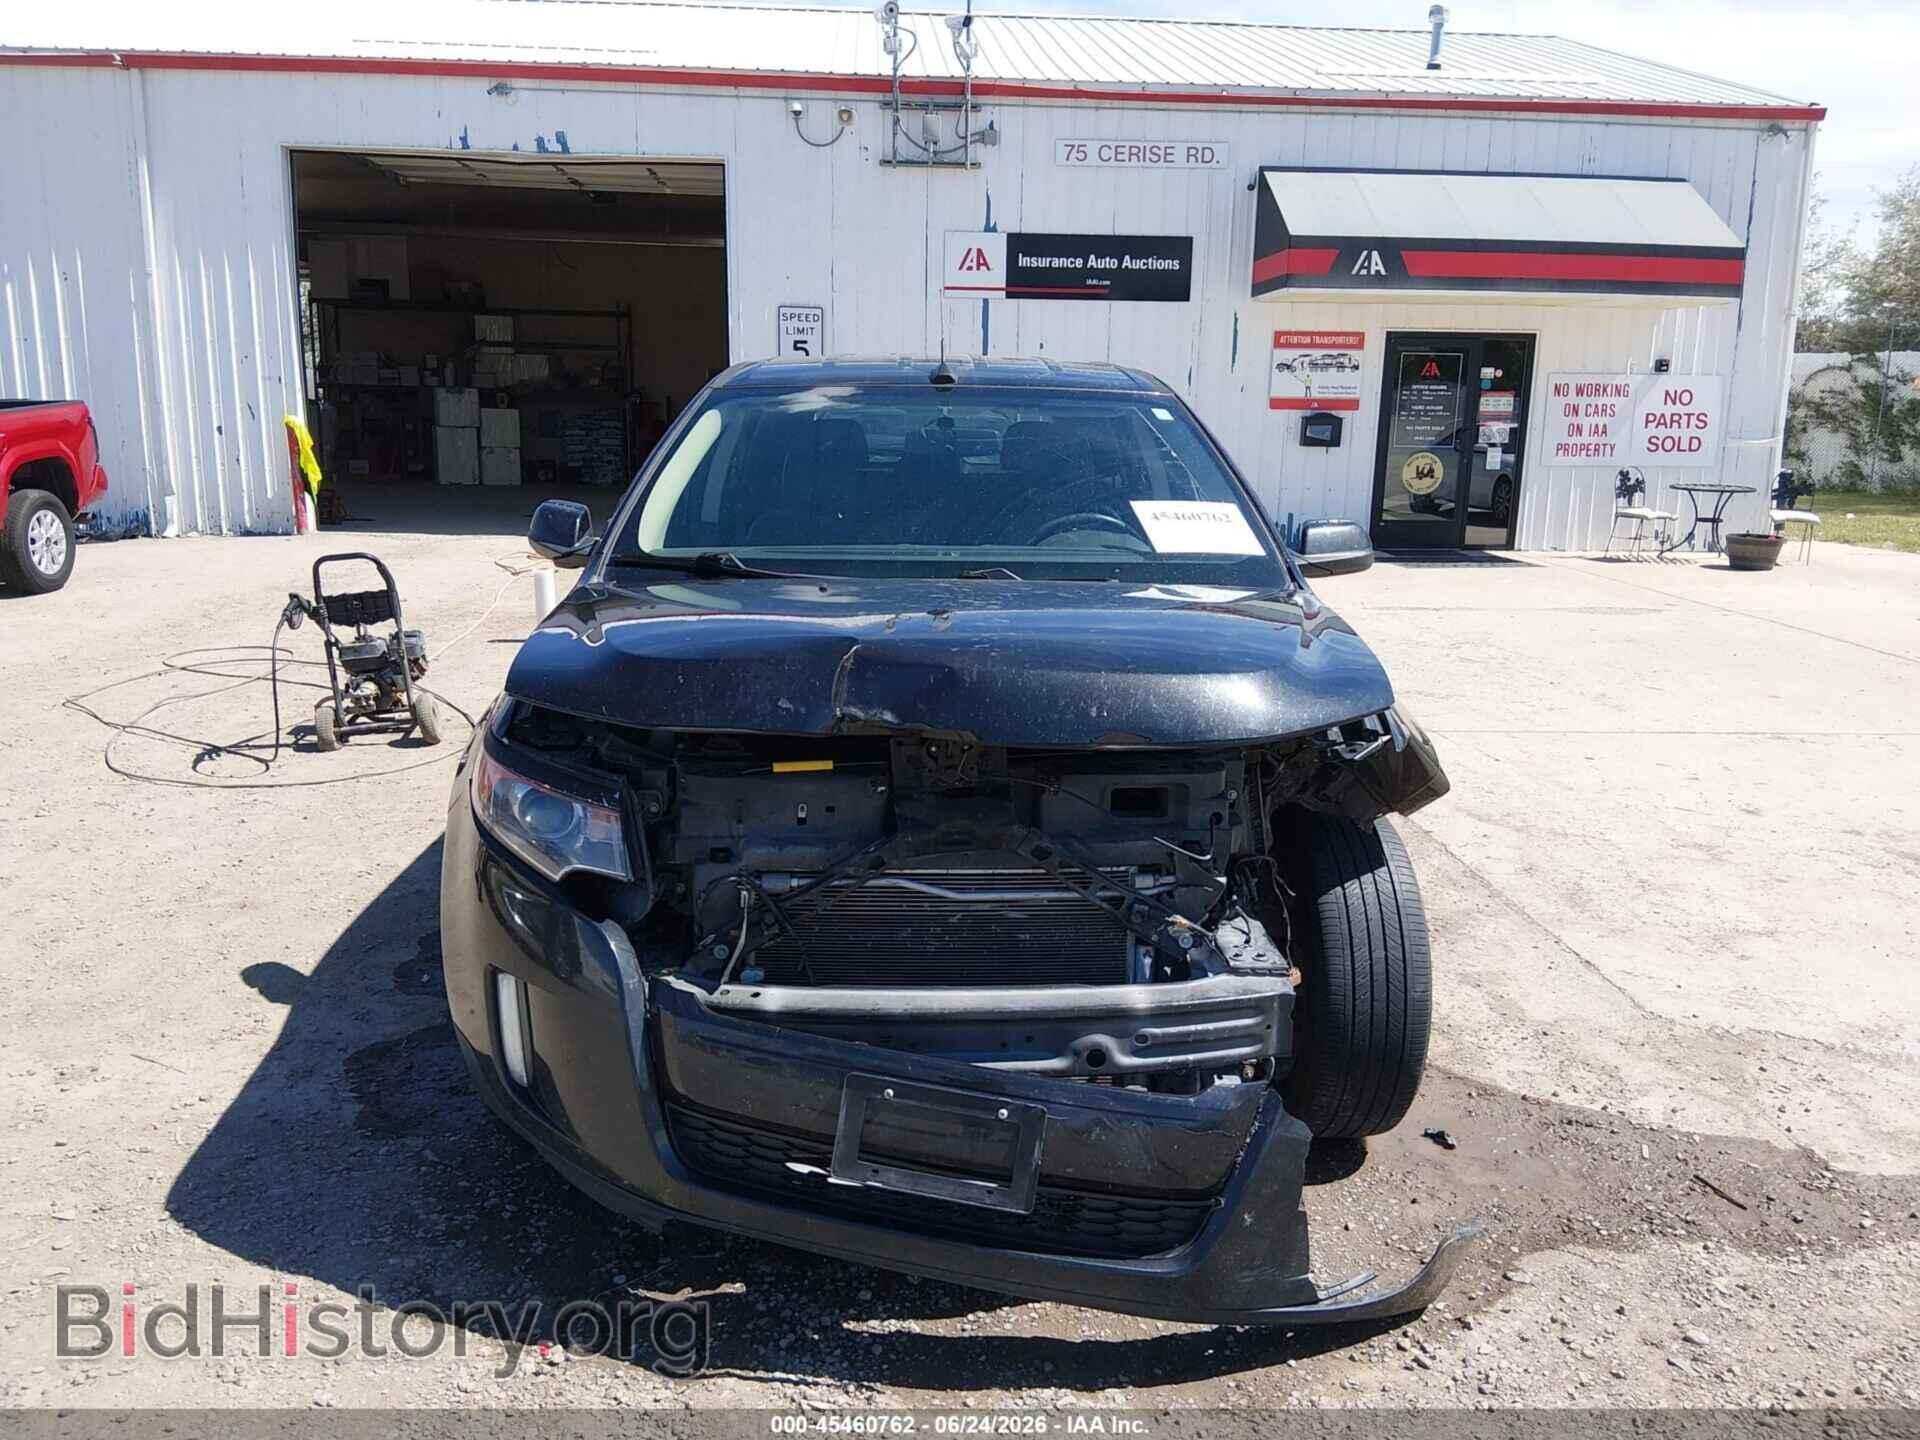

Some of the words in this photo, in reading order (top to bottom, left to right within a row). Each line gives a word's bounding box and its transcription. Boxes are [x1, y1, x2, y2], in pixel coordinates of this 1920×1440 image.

[1064, 144, 1088, 162] 75
[1098, 144, 1176, 164] CERISE
[1186, 146, 1220, 164] RD.
[1018, 253, 1083, 268] Insurance
[1087, 254, 1118, 269] Auto
[1121, 255, 1180, 270] Auctions
[782, 312, 820, 322] SPEED
[786, 326, 815, 336] LIMIT
[1280, 335, 1311, 345] ATTENTION
[1553, 383, 1570, 398] NO
[1575, 383, 1630, 398] WORKING
[1664, 389, 1693, 406] NO
[1563, 403, 1579, 417] ON
[1585, 403, 1616, 418] CARS
[1644, 412, 1708, 430] PARTS
[1567, 423, 1583, 437] ON
[1589, 423, 1608, 437] IAA
[1555, 443, 1616, 457] PROPERTY
[1646, 435, 1702, 453] SOLD
